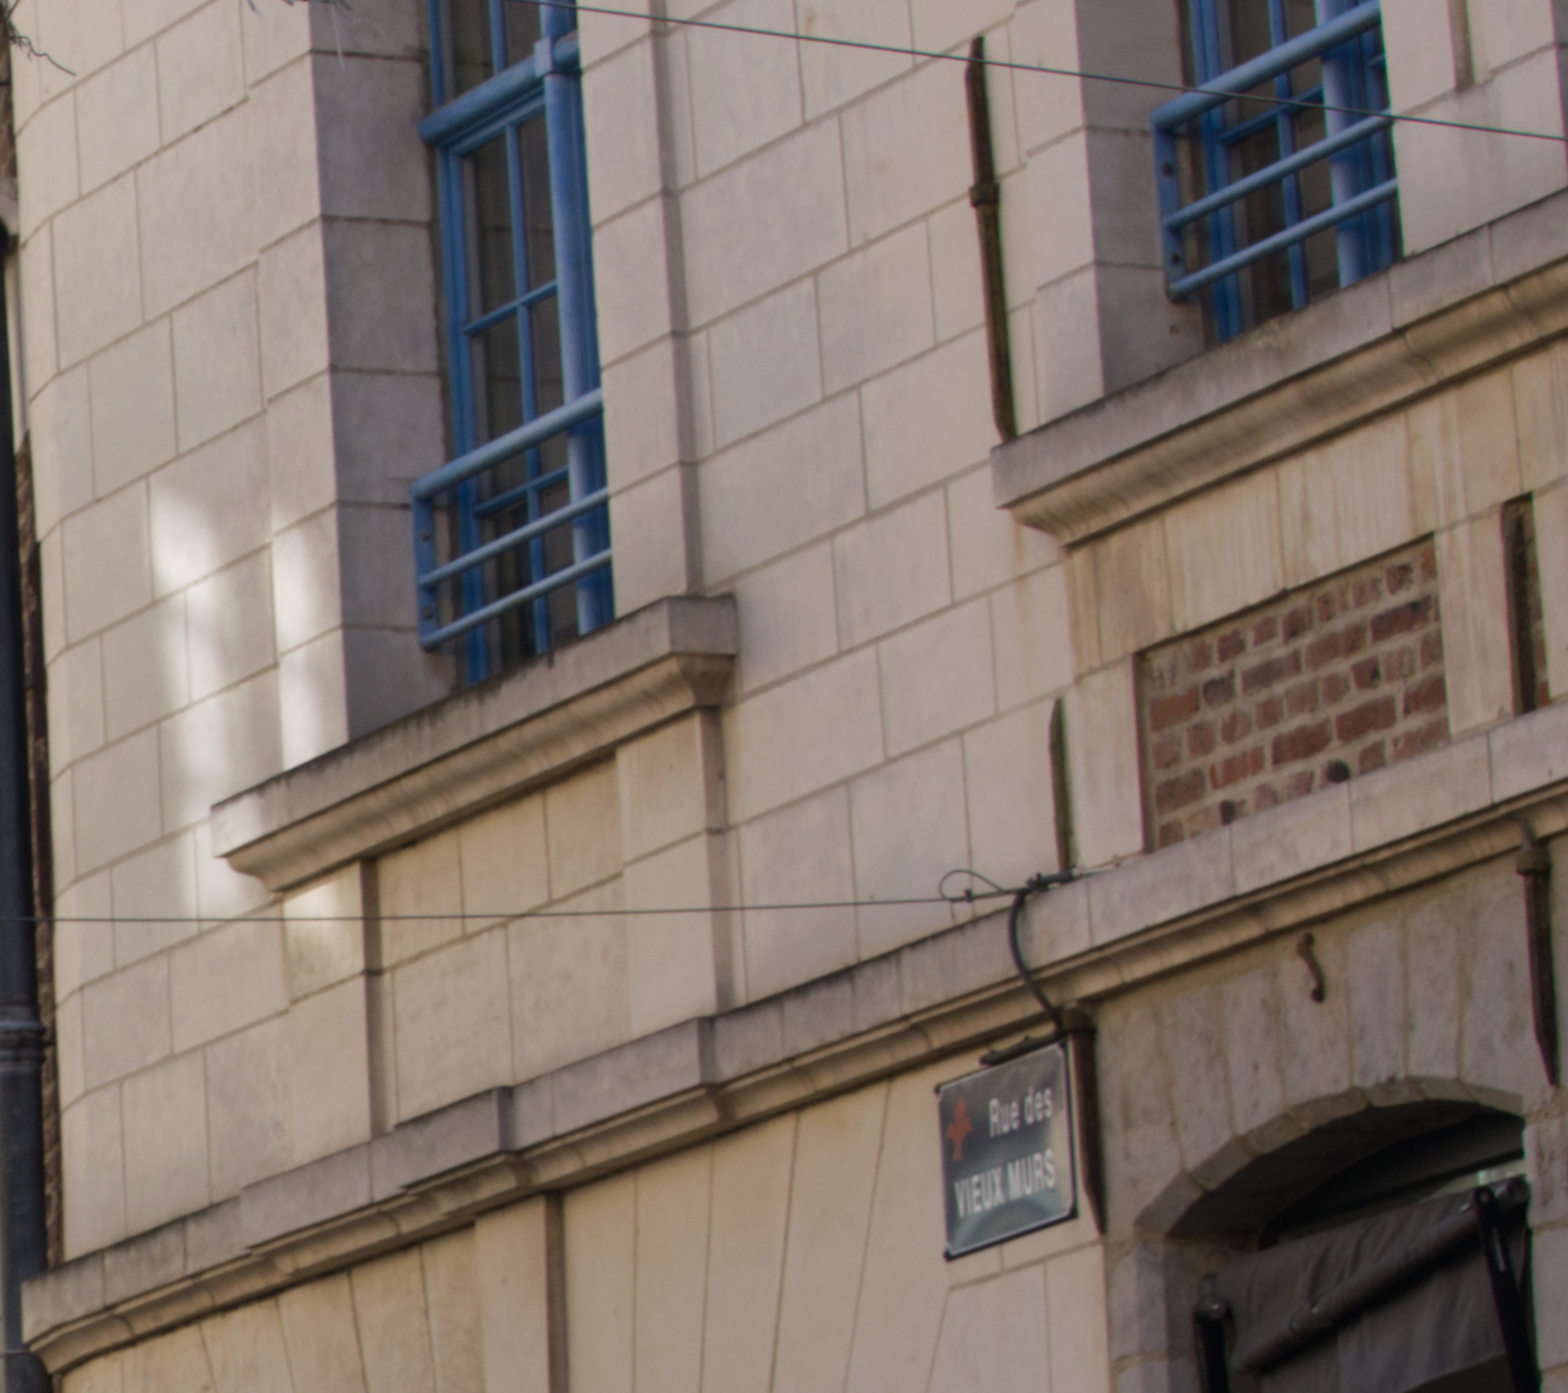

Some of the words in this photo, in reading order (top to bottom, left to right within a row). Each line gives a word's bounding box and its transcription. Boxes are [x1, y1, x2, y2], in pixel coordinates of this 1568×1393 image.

[988, 1098, 1020, 1139] Rue
[1023, 1085, 1054, 1125] des
[953, 1168, 1005, 1218] VIEUX
[1006, 1149, 1056, 1200] MURS
